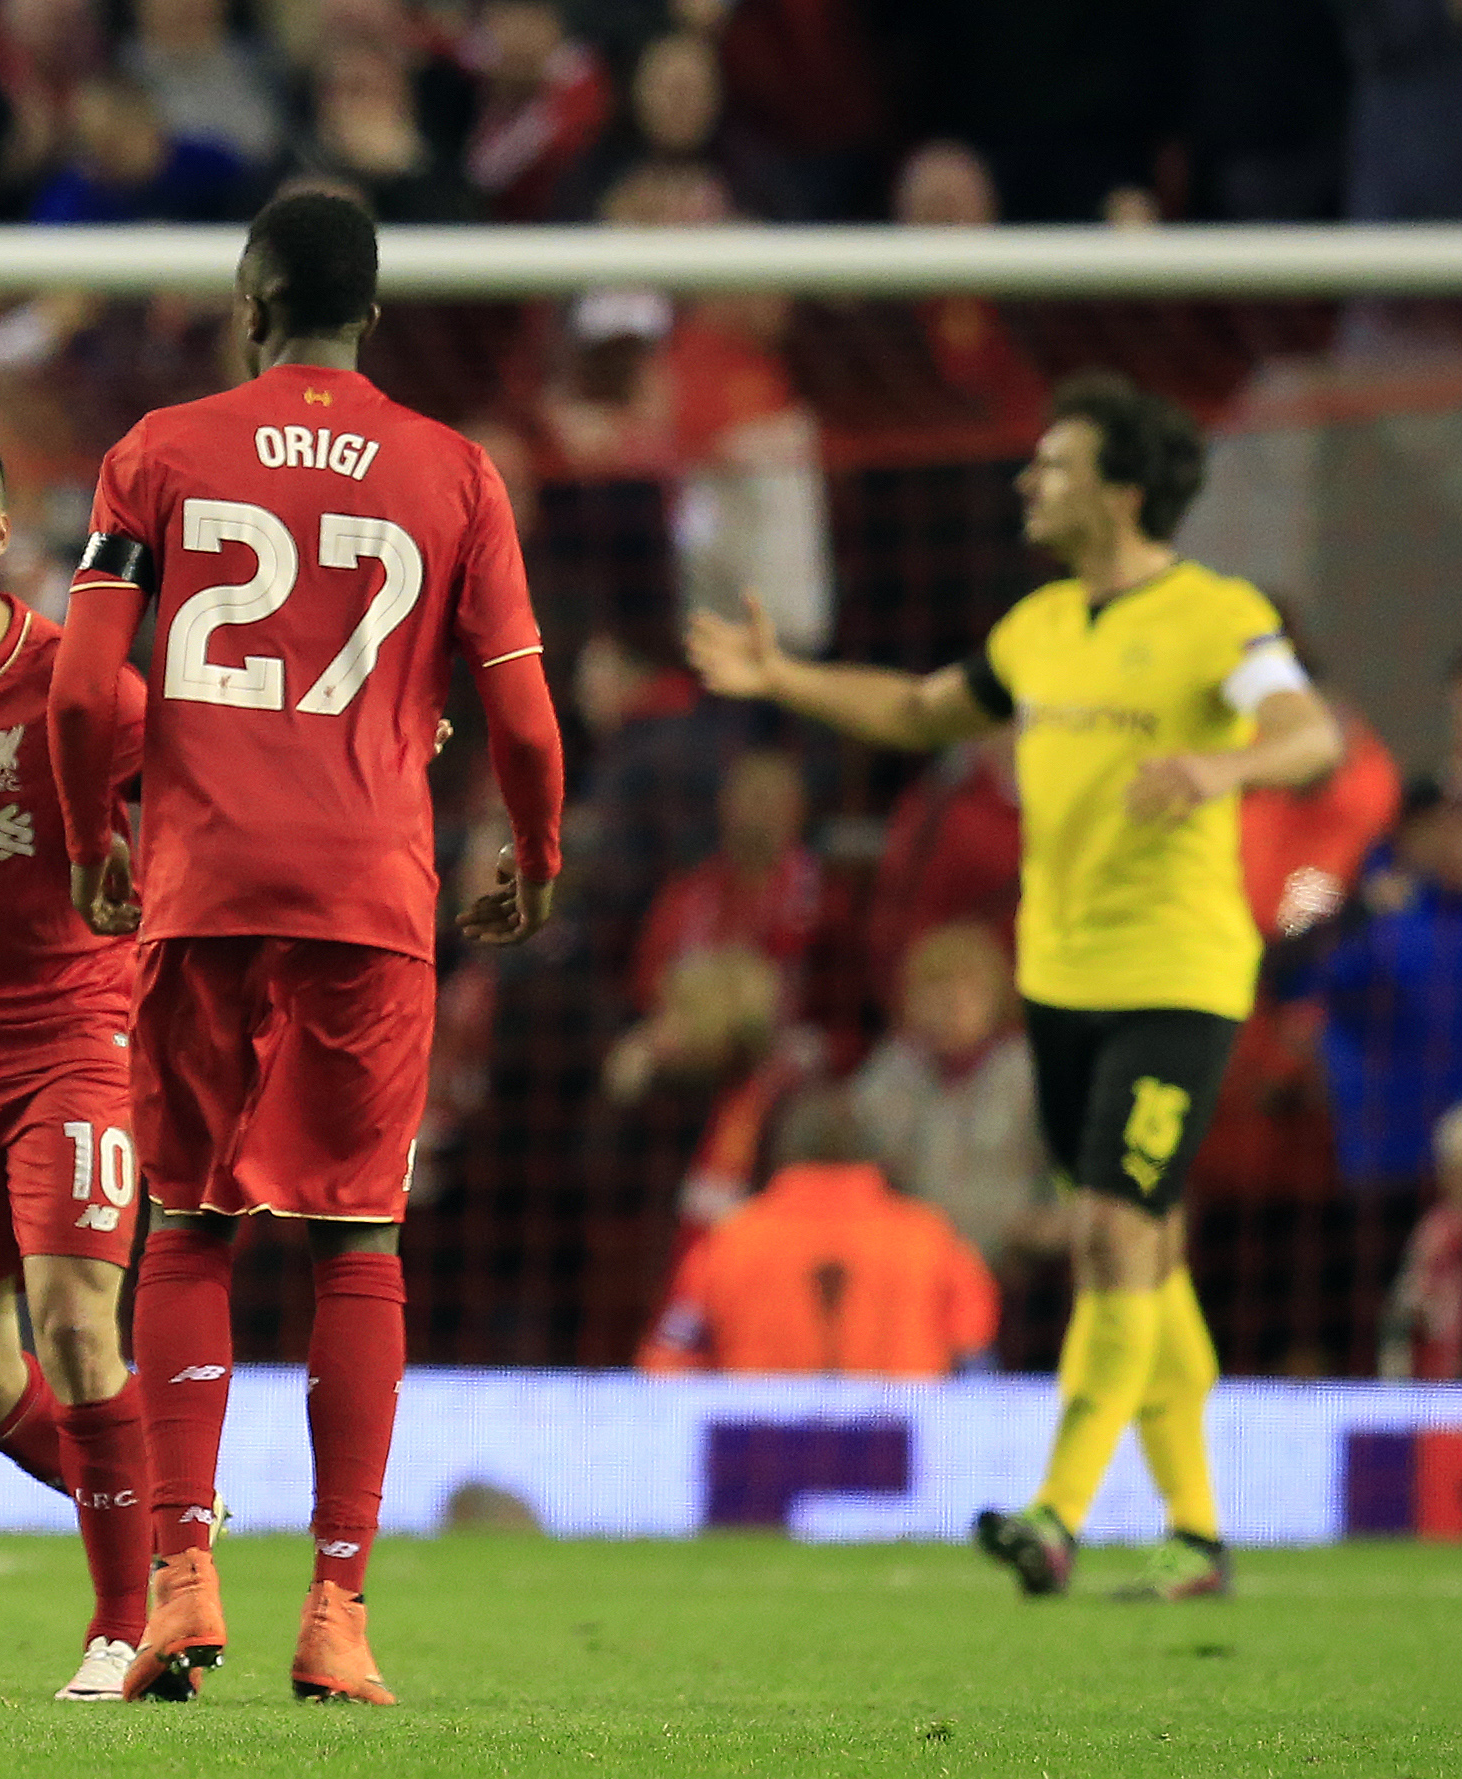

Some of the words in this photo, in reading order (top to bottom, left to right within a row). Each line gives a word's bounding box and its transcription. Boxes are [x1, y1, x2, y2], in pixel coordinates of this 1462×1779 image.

[255, 425, 381, 481] ORIGI
[164, 499, 424, 716] 27
[63, 1120, 136, 1208] 10
